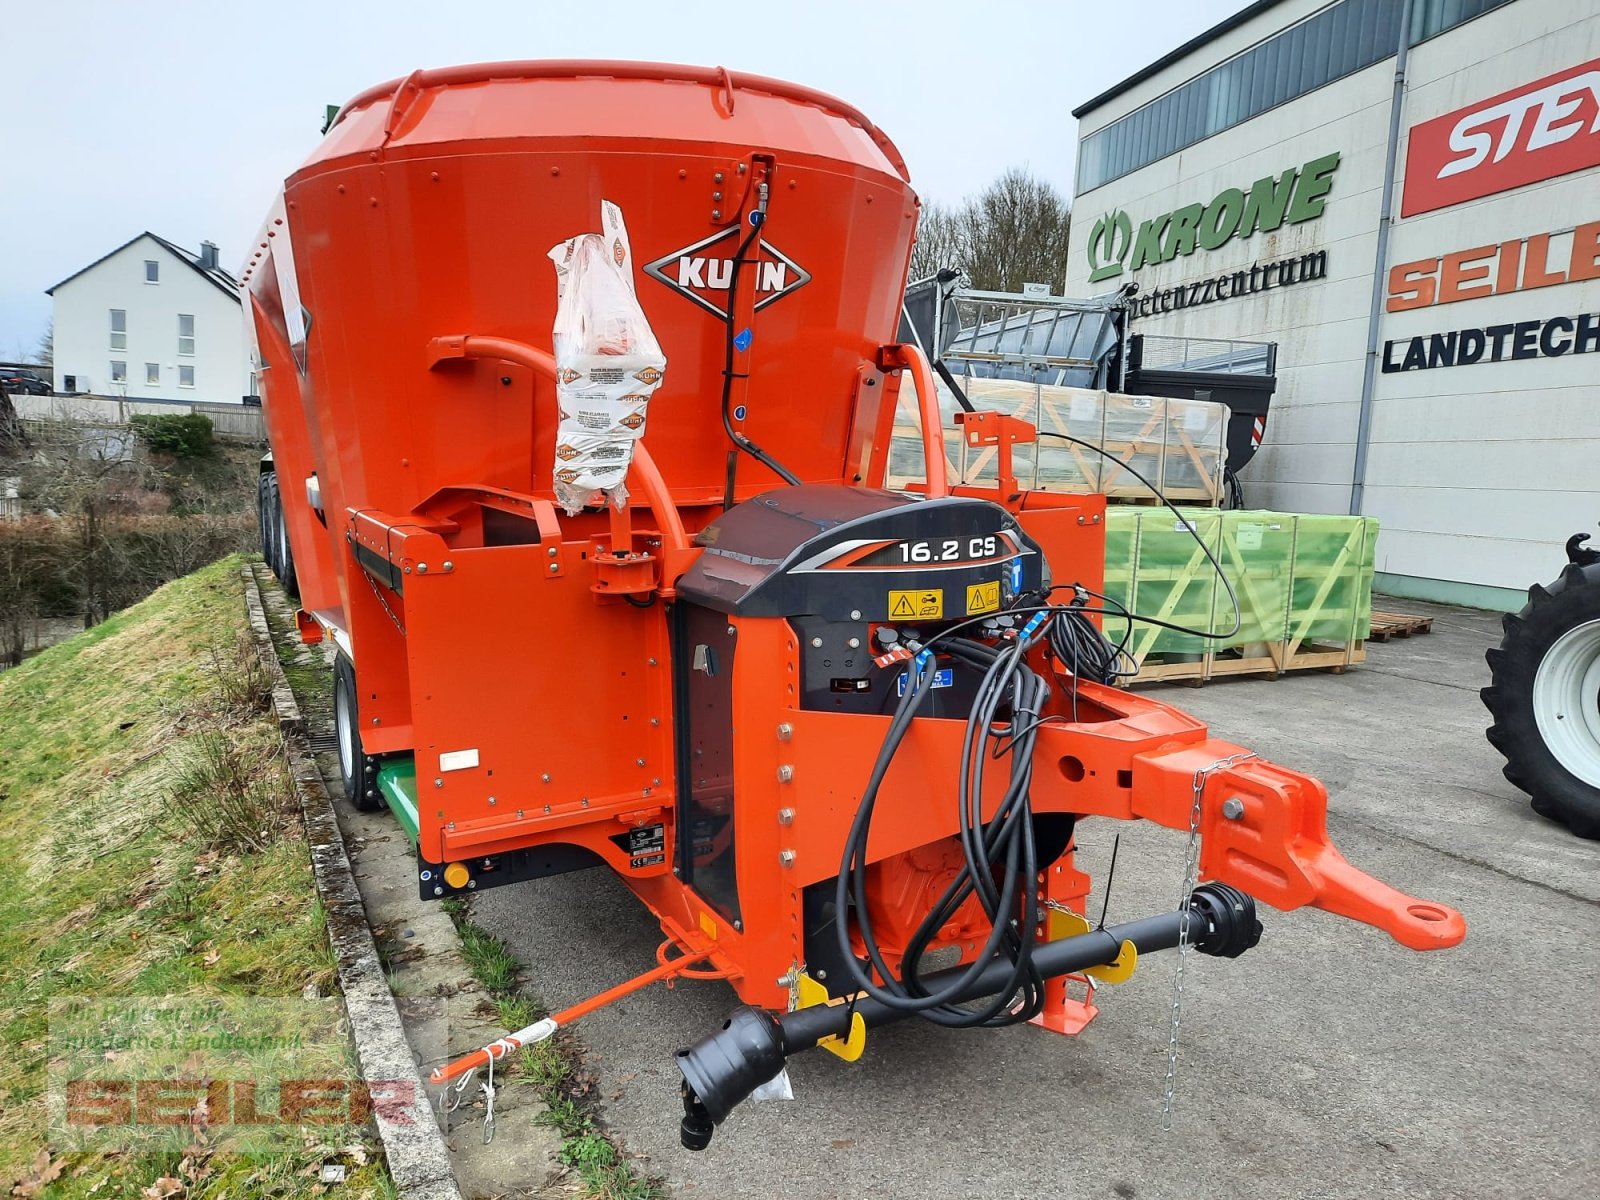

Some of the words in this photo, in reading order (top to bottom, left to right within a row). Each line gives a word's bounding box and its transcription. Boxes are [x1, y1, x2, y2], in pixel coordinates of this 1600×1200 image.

[1130, 151, 1340, 271] KRONE
[678, 255, 786, 292] KUN
[899, 540, 959, 563] 16.2
[969, 536, 996, 558] CS
